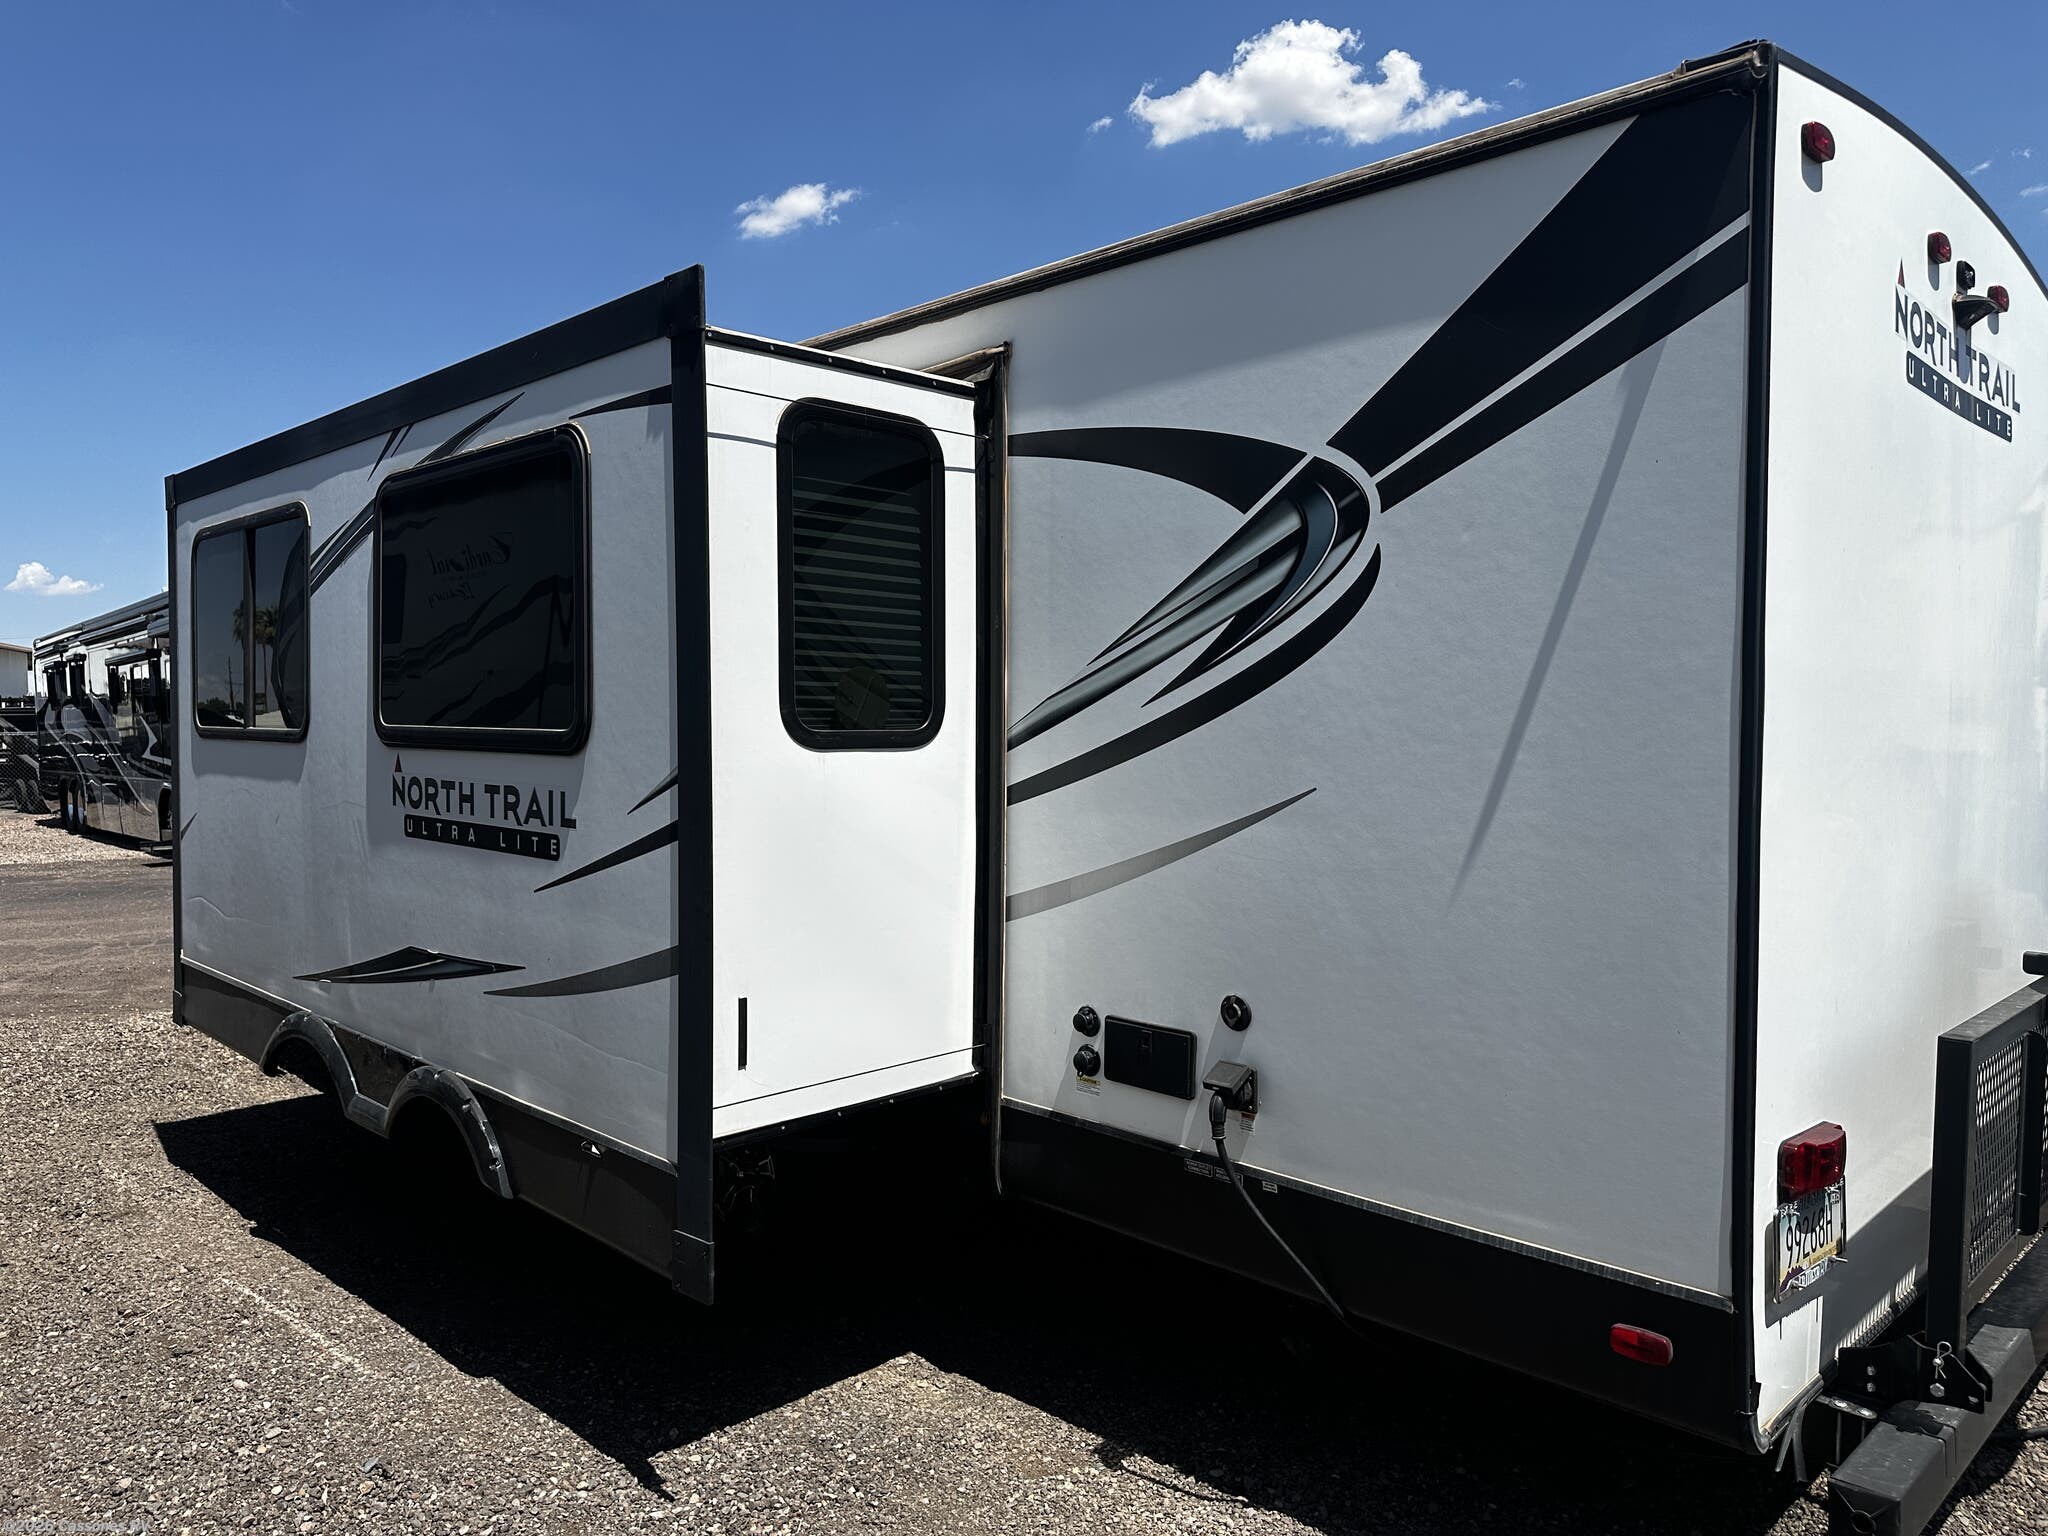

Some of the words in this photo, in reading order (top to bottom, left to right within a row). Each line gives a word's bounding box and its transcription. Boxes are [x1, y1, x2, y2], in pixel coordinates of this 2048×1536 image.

[1895, 285, 1960, 378] NORTH
[1965, 345, 2021, 414] TRAIL
[1908, 357, 1961, 410] ULTRA
[1976, 402, 2012, 437] LITE
[392, 774, 475, 816] NORTH
[484, 784, 577, 830] TRAIL
[406, 818, 476, 843] ULTRA
[499, 833, 558, 856] LITE
[1785, 1204, 1833, 1269] 99268H
